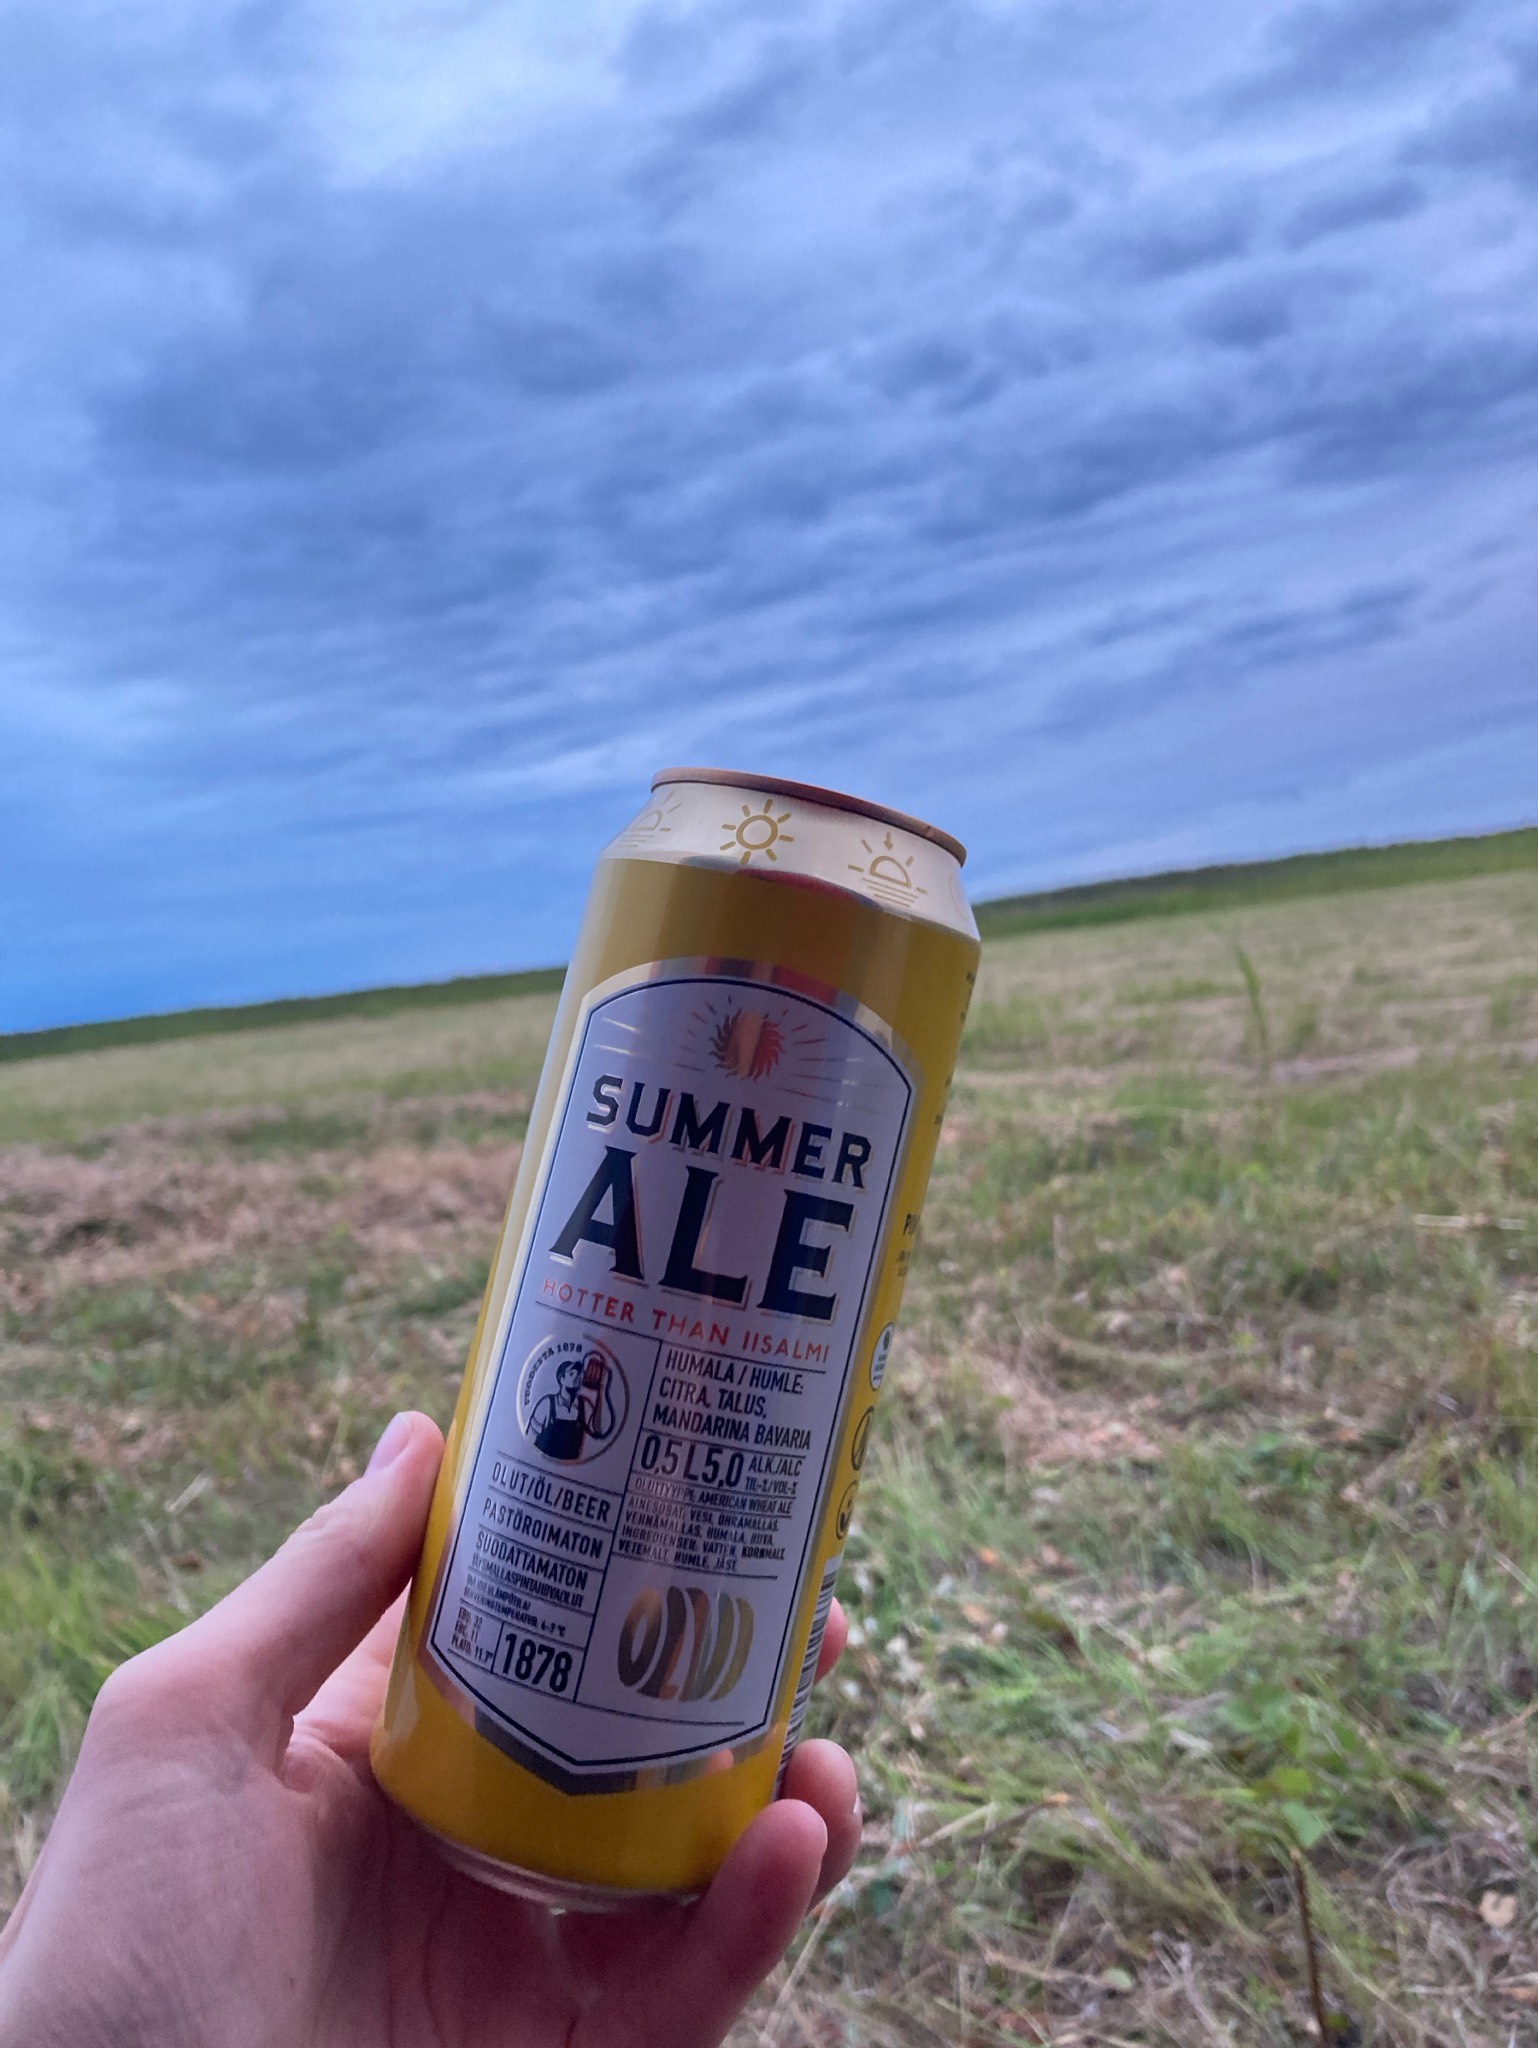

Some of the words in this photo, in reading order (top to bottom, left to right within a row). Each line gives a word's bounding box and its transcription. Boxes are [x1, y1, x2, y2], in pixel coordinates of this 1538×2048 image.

[586, 1074, 872, 1189] SUMMER
[548, 1145, 855, 1322] ALE
[544, 1278, 635, 1323] HOTTER
[653, 1309, 730, 1346] THAN
[743, 1331, 830, 1364] IISALMI
[666, 1350, 734, 1385] HUMALA
[738, 1366, 748, 1385] /
[652, 1403, 750, 1442] MANDARINA
[754, 1423, 811, 1450] BAVARIA
[718, 1388, 767, 1419] TALUS,
[641, 1435, 682, 1474] 0,5
[683, 1443, 699, 1481] L
[702, 1448, 744, 1488] 5,0
[482, 1497, 604, 1559] PASTÖROIMATON
[699, 1490, 747, 1510] AMERICAN
[748, 1497, 778, 1513] WHEAT
[777, 1501, 793, 1514] ALE
[476, 1531, 588, 1590] SUODATTAMATON
[503, 1633, 573, 1693] 1878
